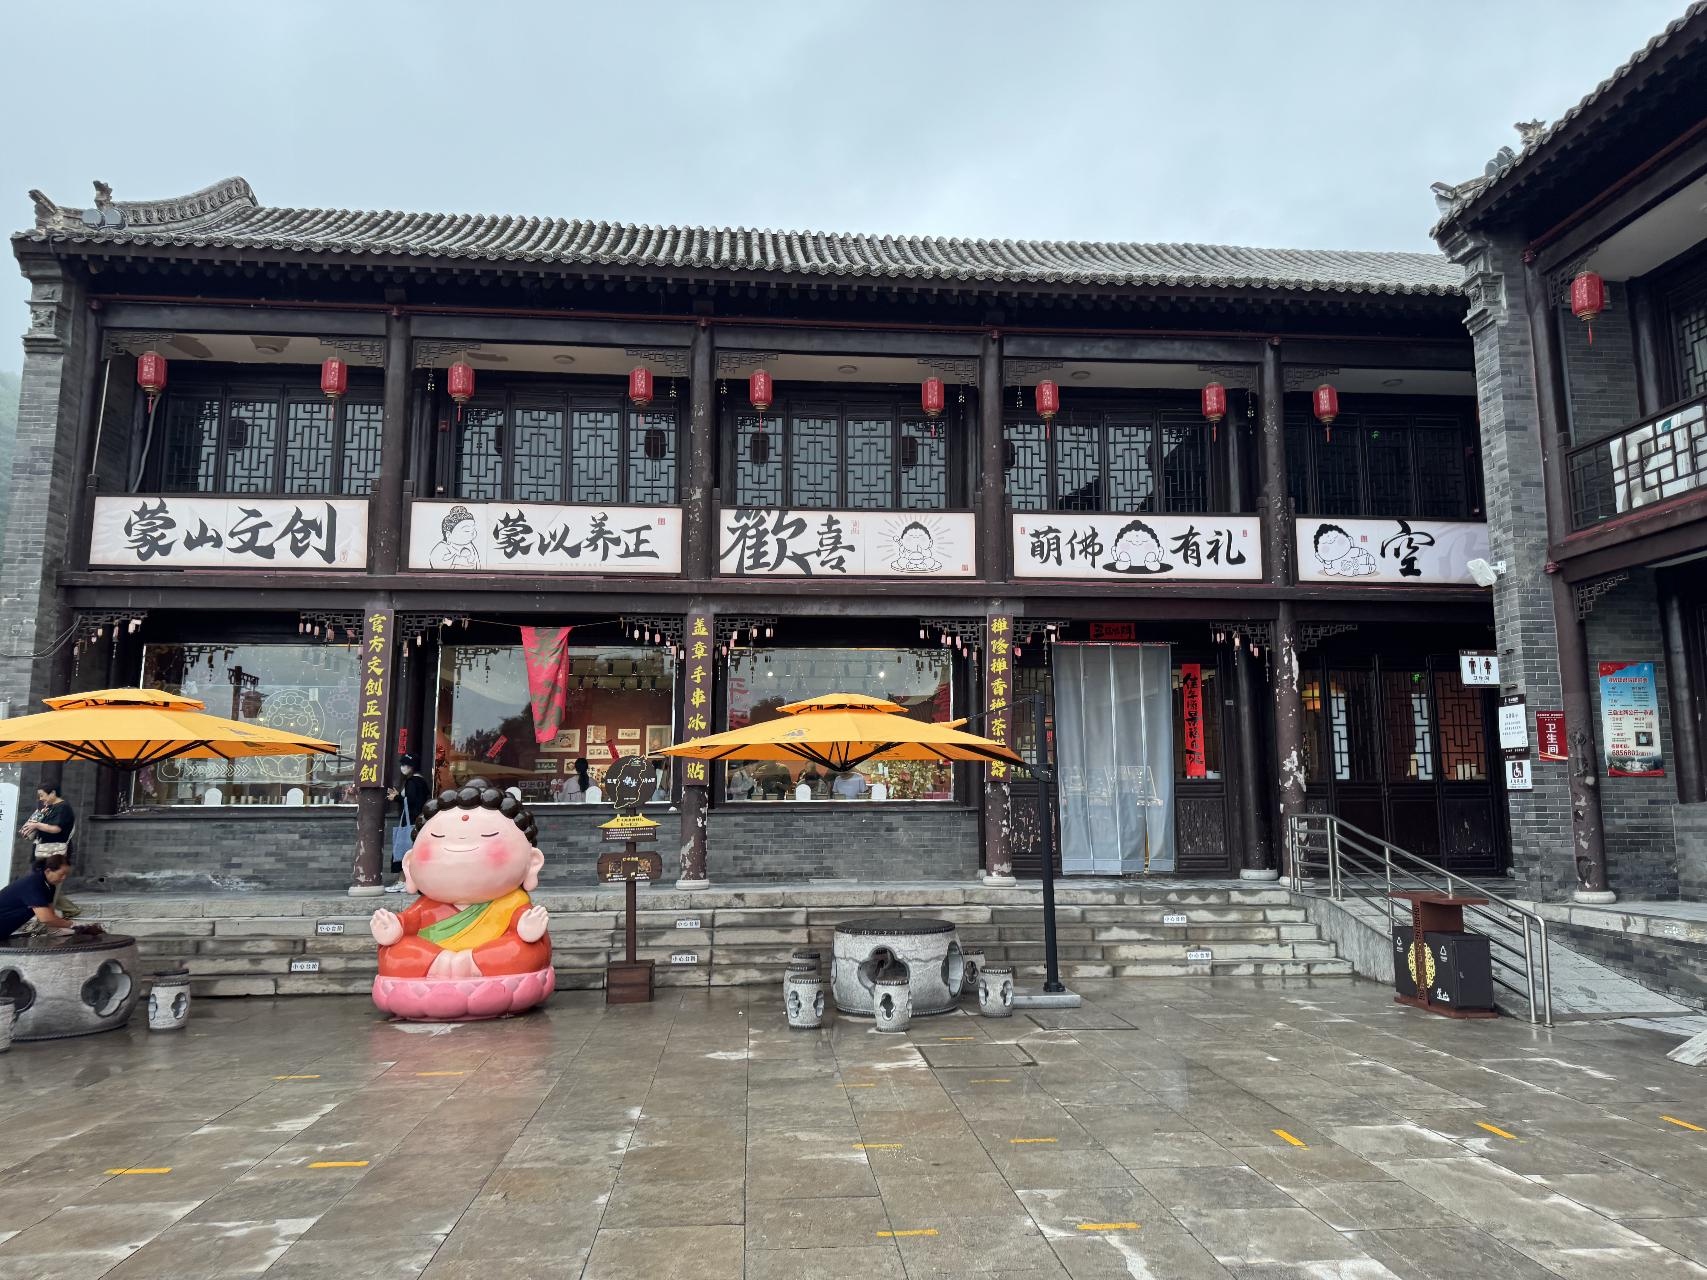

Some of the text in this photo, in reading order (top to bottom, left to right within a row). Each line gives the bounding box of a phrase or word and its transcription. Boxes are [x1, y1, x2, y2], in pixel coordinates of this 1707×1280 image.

[123, 497, 337, 564] 蒙山文创
[492, 508, 660, 561] 蒙以养正
[1029, 524, 1246, 568] 萌佛 有礼
[1380, 519, 1435, 577] 空
[359, 613, 387, 783] 官方文创正版原创
[687, 617, 709, 780] 盖章手串冰贴
[1545, 723, 1559, 755] 卫生间
